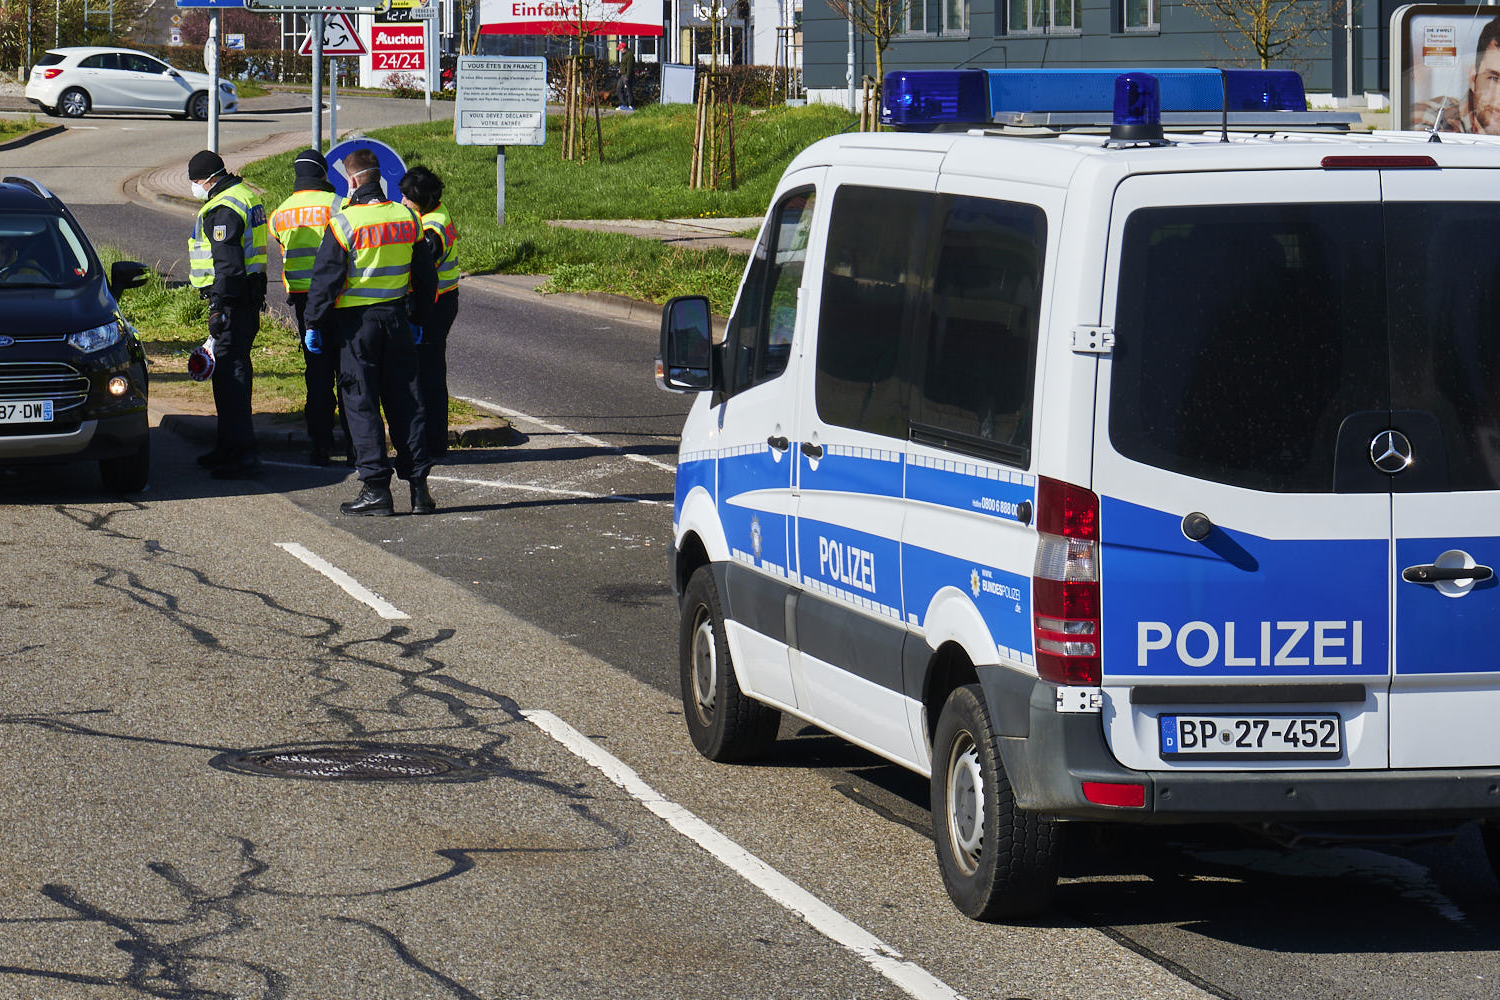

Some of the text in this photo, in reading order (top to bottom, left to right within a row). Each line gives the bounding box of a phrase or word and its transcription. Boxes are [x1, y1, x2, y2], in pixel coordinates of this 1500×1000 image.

[512, 3, 579, 17] Einfahrt
[375, 31, 423, 45] Auchan
[378, 54, 420, 69] 24/24
[276, 206, 326, 230] POLIZEI
[358, 221, 413, 248] POLIZEI
[819, 536, 876, 594] POLIZEI
[982, 579, 1020, 601] BUNDESPOLIZEI
[1137, 620, 1363, 667] POLIZEI
[1179, 720, 1217, 748] BP
[1235, 720, 1337, 748] 27-452
